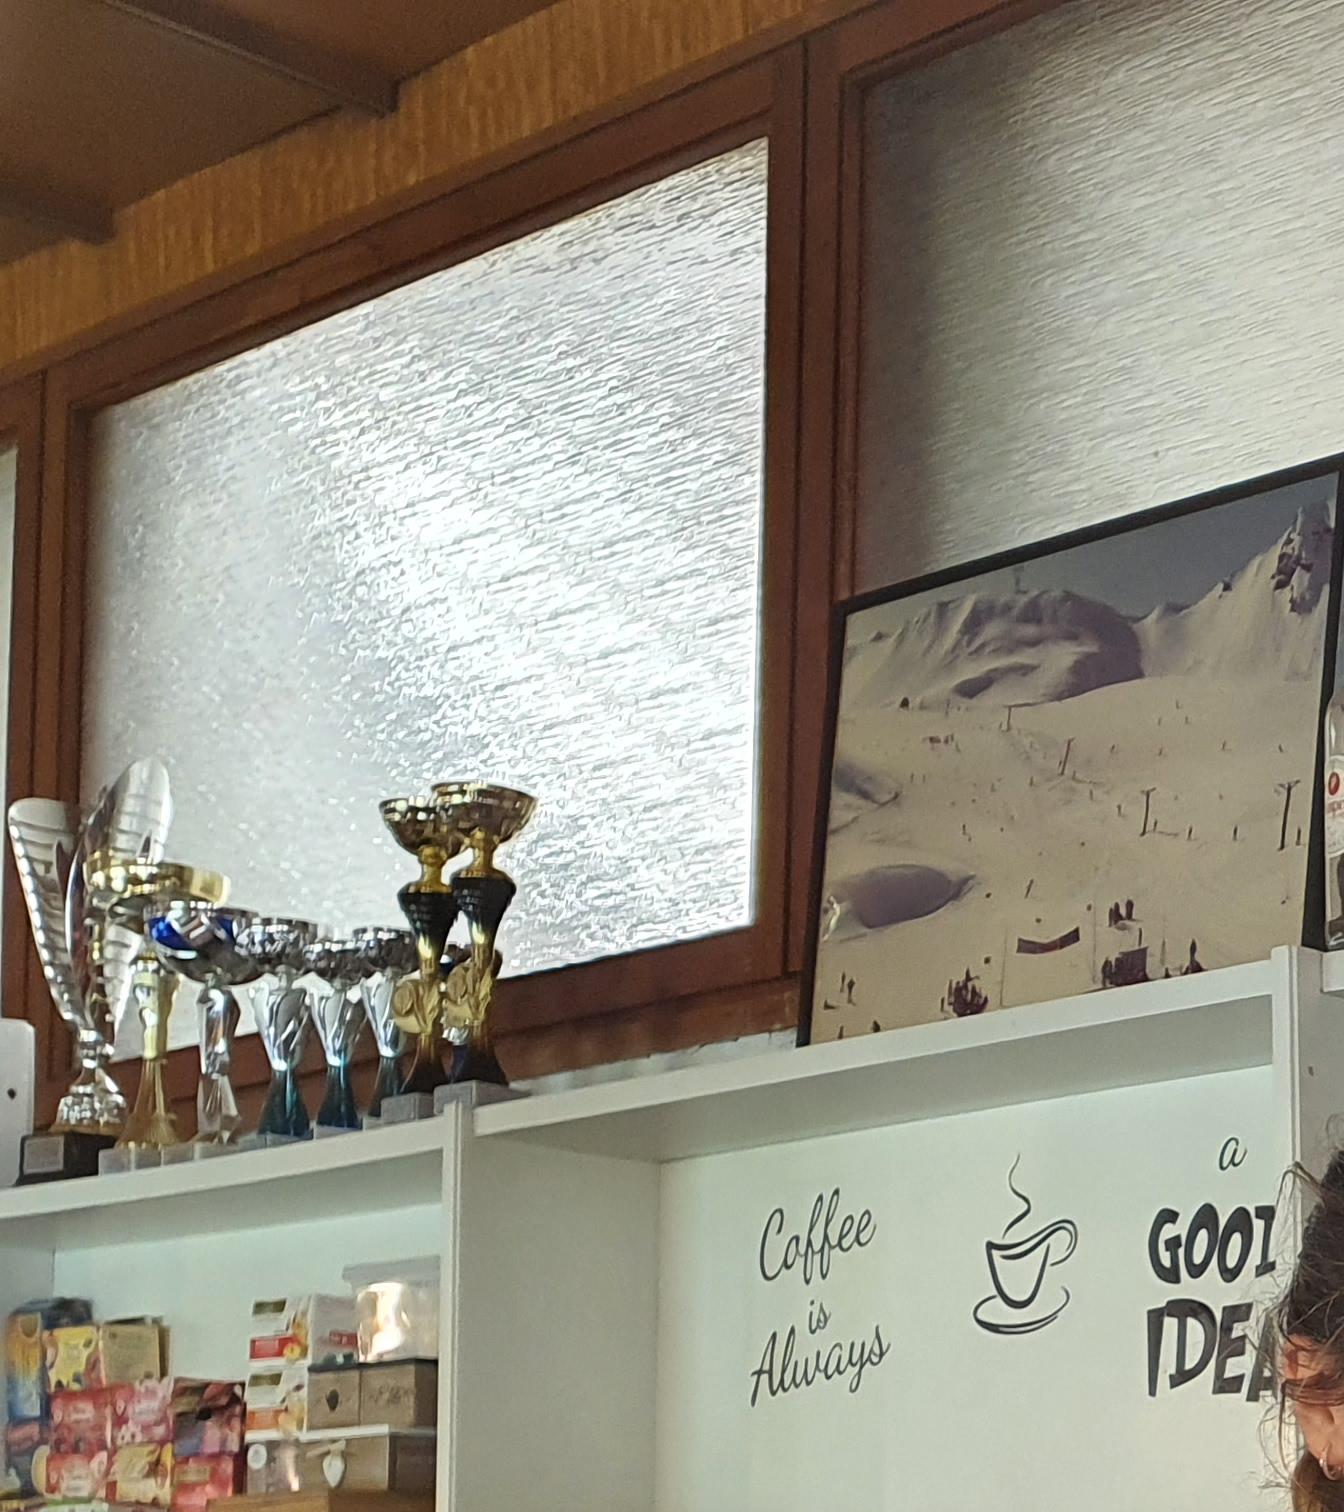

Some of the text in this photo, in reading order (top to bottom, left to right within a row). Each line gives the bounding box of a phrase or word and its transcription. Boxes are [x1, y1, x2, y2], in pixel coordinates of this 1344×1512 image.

[1218, 1136, 1248, 1172] a
[759, 1187, 878, 1286] Coffee
[807, 1299, 831, 1336] is
[749, 1325, 891, 1407] Always
